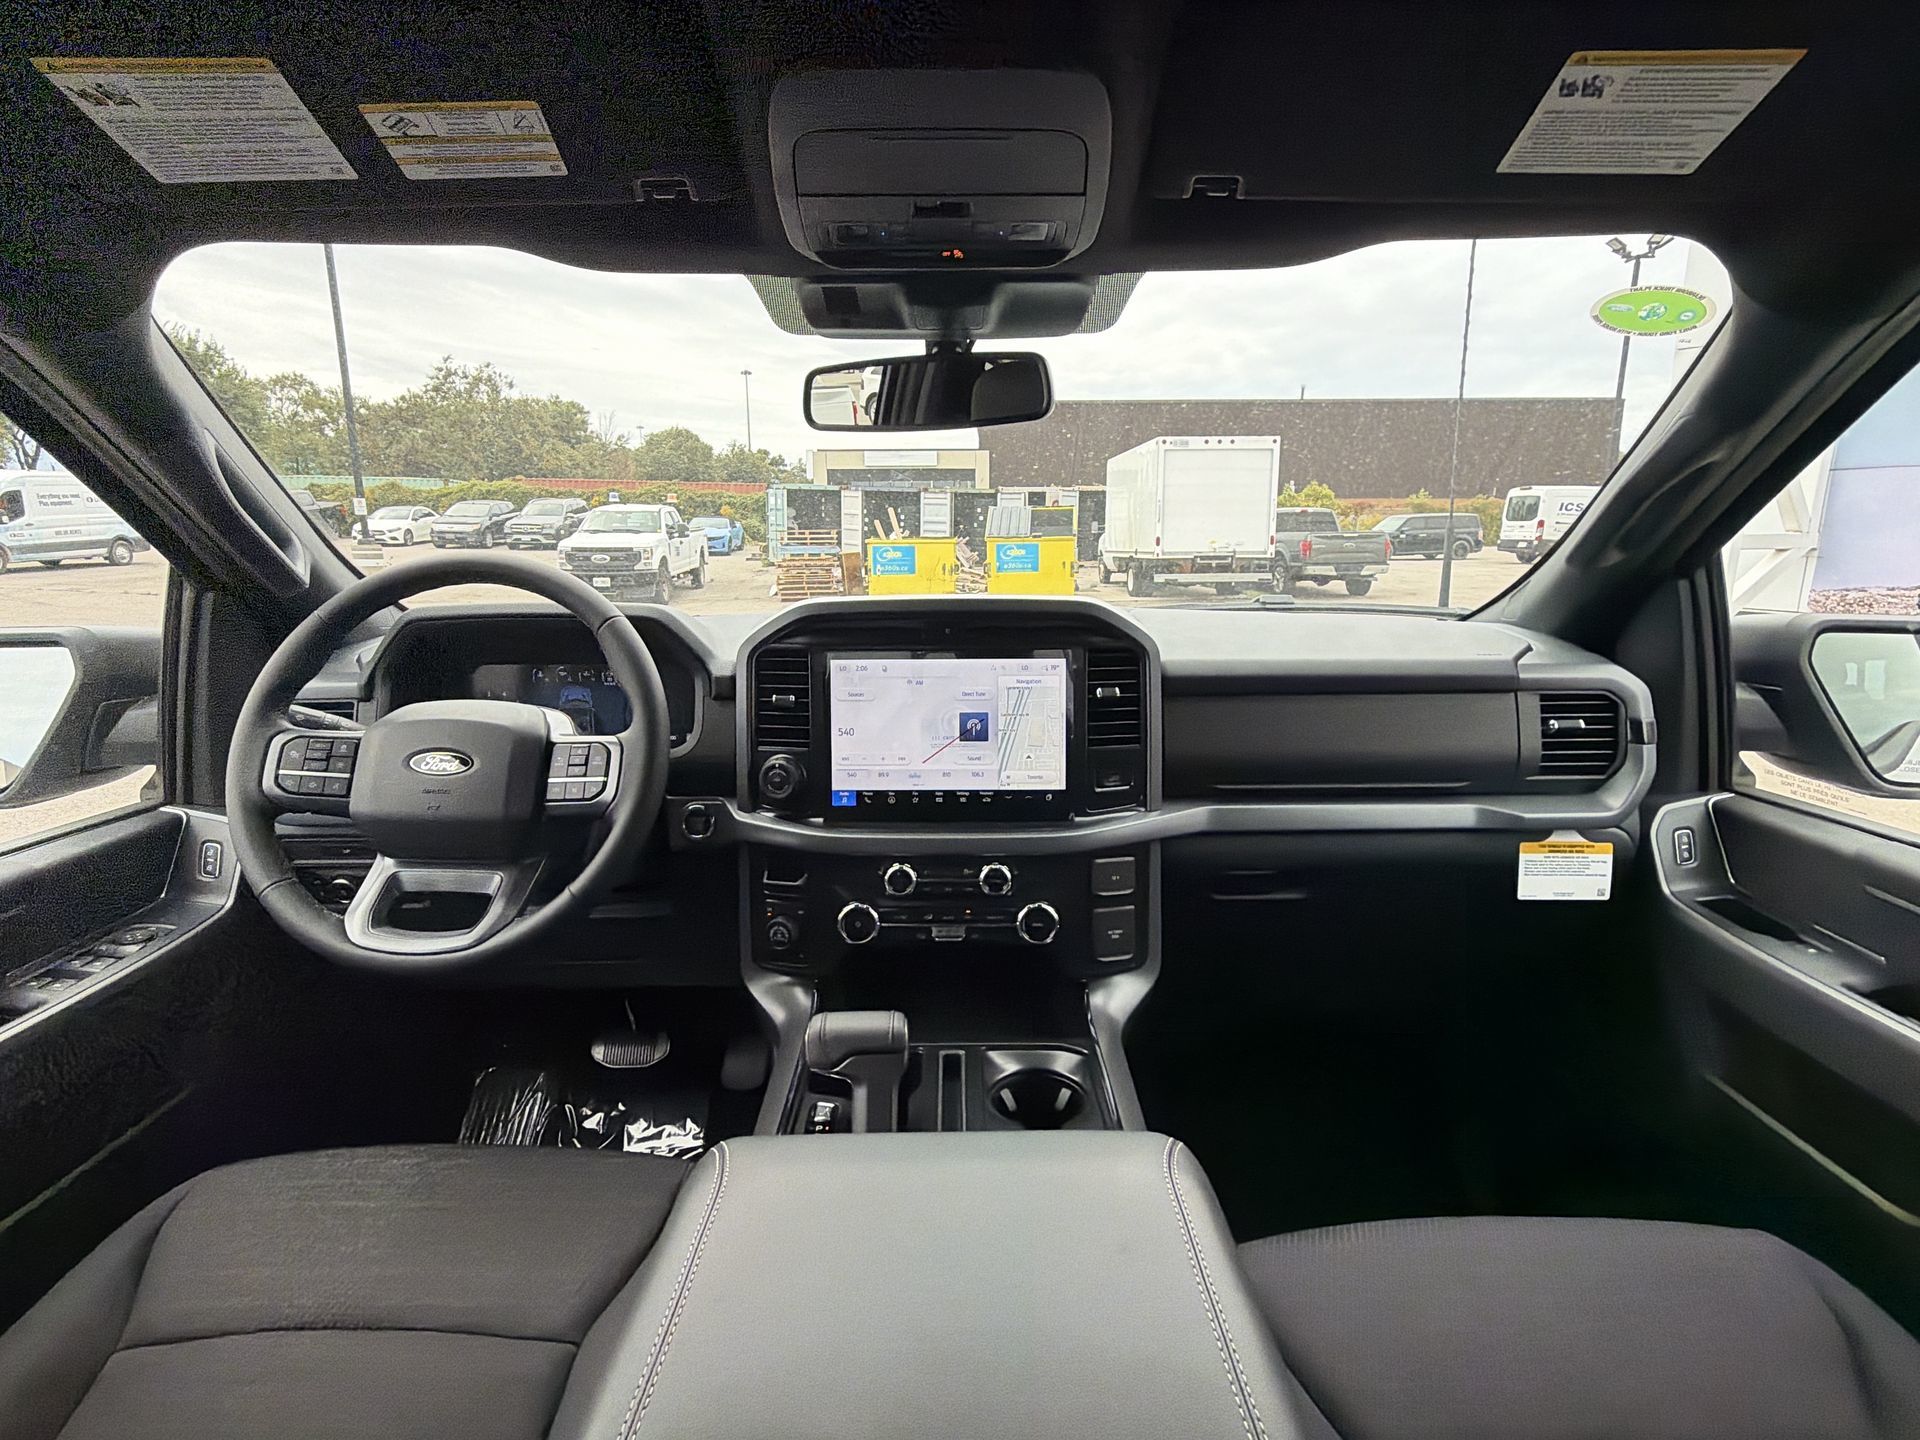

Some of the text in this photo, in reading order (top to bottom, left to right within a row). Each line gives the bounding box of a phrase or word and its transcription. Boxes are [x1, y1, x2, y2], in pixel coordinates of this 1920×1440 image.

[1559, 502, 1584, 512] ICS
[838, 728, 855, 736] 540
[421, 754, 460, 771] Ford
